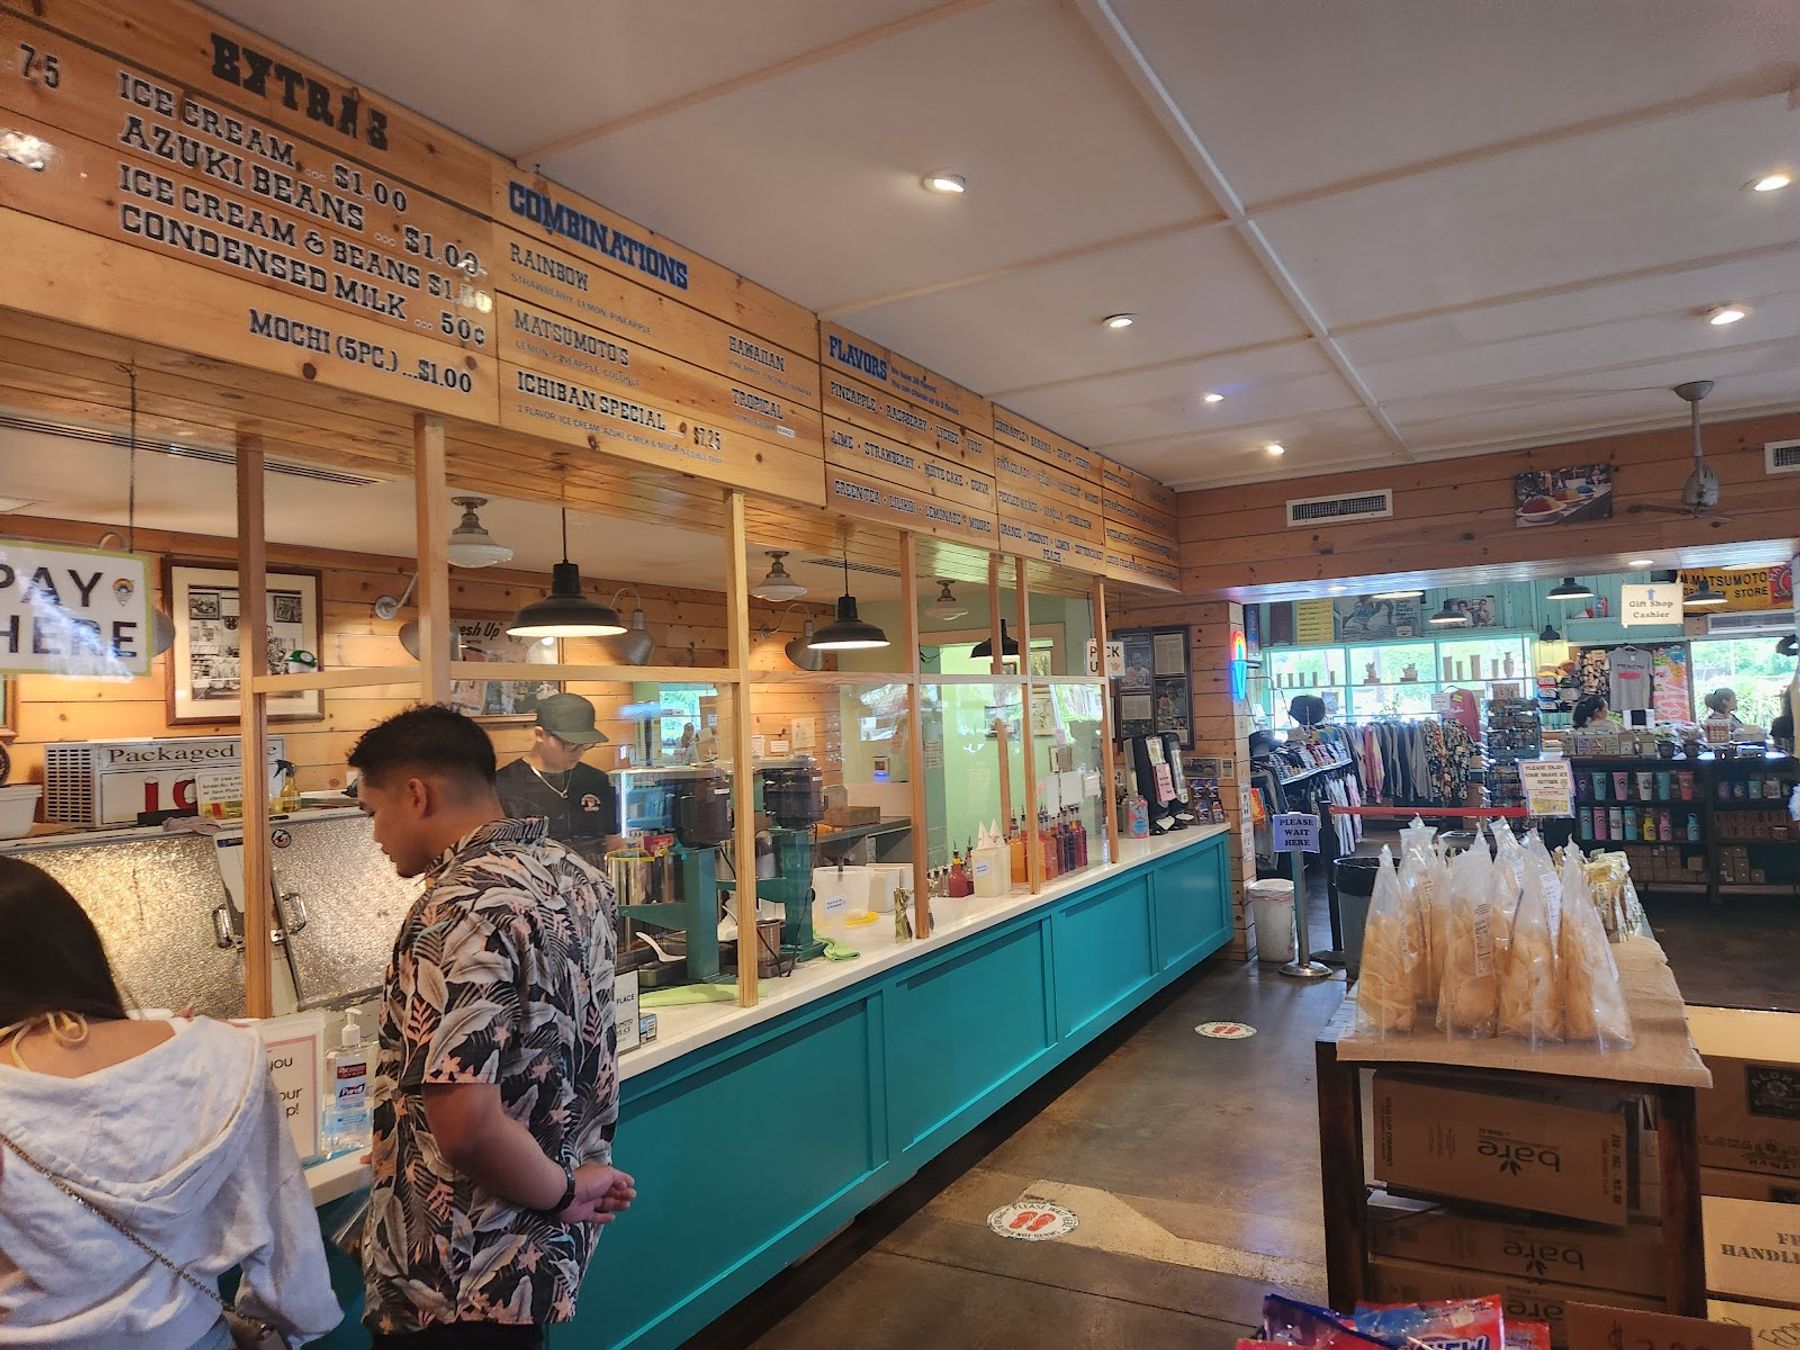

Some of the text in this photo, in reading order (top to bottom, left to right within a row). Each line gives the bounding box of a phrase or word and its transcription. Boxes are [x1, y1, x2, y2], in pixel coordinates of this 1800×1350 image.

[211, 32, 389, 151] EXTRAS
[118, 71, 408, 213] ICE CREAM $1.00
[120, 115, 479, 275] AZUKI BEANS $1.00
[119, 163, 173, 202] ICE
[183, 185, 295, 250] CREAM
[304, 231, 325, 255] &
[332, 239, 420, 290] BEANS
[508, 180, 689, 290] COMBINATIONS
[120, 203, 485, 346] CONDENSED MILK 50¢
[509, 242, 589, 291] RAINBOW
[249, 308, 330, 355] MOCHI
[336, 336, 399, 374] (5PC.)
[514, 309, 629, 366] MATSUMOTO'S
[828, 334, 888, 381] FLAVORS
[516, 370, 596, 412] ICHIBAN
[599, 394, 666, 431] SPECIAL
[830, 381, 876, 411] PINEAPPLE
[886, 404, 928, 431] RASPBERRY
[936, 424, 959, 445] LYCHEE
[832, 430, 854, 449] LIME
[864, 442, 914, 470] STRAWBERRY
[946, 470, 964, 486] CAKE
[834, 480, 862, 500] GREEN
[862, 487, 881, 504] TEA
[1629, 600, 1674, 609] Gift Shop
[1734, 586, 1769, 599] STORE
[458, 621, 500, 641] esh Up
[1633, 611, 1670, 619] Cashier
[1090, 645, 1120, 658] PCK
[1090, 661, 1098, 673] U
[107, 744, 235, 764] Packaged
[143, 775, 197, 813] IC
[1280, 818, 1314, 826] PLEASE
[286, 1103, 300, 1119] p!
[1476, 1138, 1561, 1173] bare
[1012, 1202, 1045, 1210] PLEASE
[1503, 1241, 1585, 1272] bare
[1507, 1299, 1564, 1322] are
